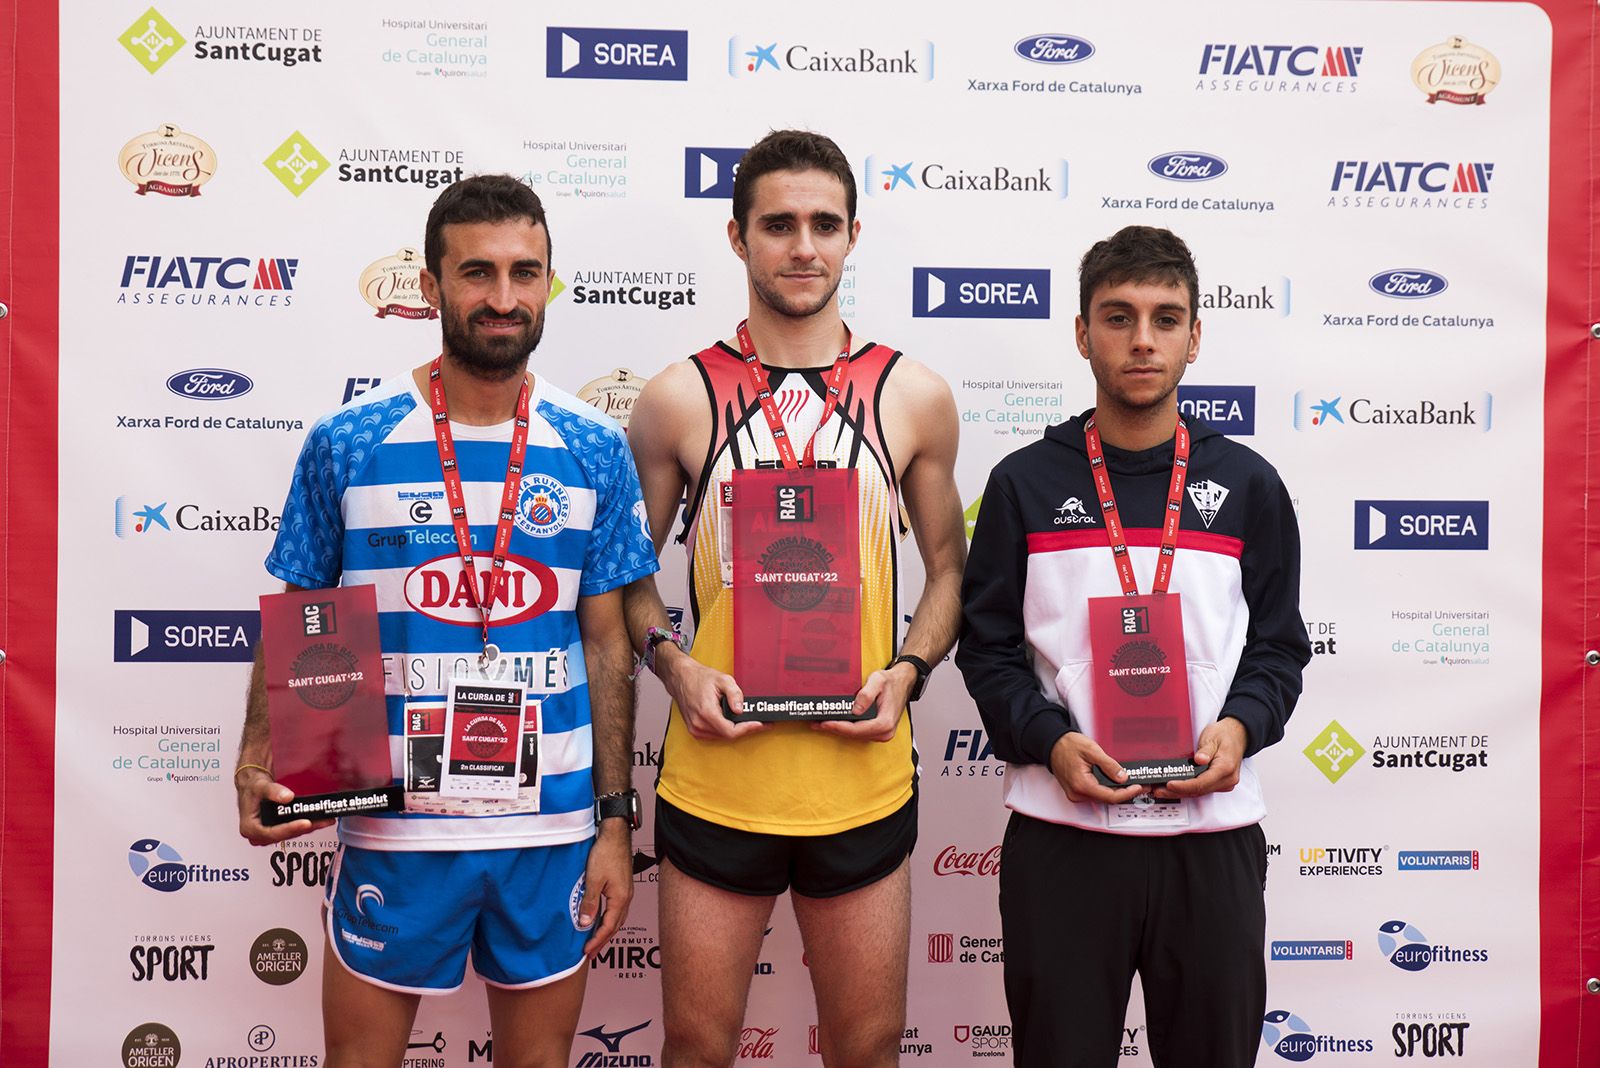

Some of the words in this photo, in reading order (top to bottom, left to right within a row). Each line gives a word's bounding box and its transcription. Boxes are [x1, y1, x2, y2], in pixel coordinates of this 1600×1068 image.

[382, 18, 426, 32] Hospital
[429, 19, 488, 31] Universitari
[195, 25, 299, 41] AJUNTAMENT
[303, 28, 323, 42] DE
[426, 32, 488, 49] General
[194, 40, 322, 67] SantCugat
[382, 48, 402, 63] de
[406, 49, 488, 66] Catalunya
[594, 42, 676, 67] SOREA
[1029, 37, 1080, 61] Ford
[785, 44, 918, 74] CaixaBank
[1198, 44, 1319, 77] FIATC
[967, 79, 1008, 92] Xarxa
[1012, 79, 1044, 92] Ford
[1048, 80, 1066, 93] de
[1068, 80, 1142, 96] Catalunya
[1195, 79, 1358, 94] ASSEGURANCES
[523, 140, 566, 152] Hospital
[569, 141, 627, 152] Universitari
[338, 148, 442, 163] AJUNTAMENT
[446, 150, 464, 164] DE
[566, 154, 627, 169] General
[1163, 155, 1212, 178] Ford
[338, 164, 464, 188] SantCugat
[523, 170, 542, 184] de
[546, 170, 627, 188] Catalunya
[921, 163, 1053, 193] CaixaBank
[1330, 160, 1450, 194] FIATC
[148, 184, 189, 194] AGRAMUNT
[1101, 196, 1142, 209] Xarxa
[1146, 196, 1178, 210] Ford
[1181, 197, 1198, 210] de
[1202, 198, 1274, 213] Catalunya
[1328, 196, 1488, 210] ASSEGURANCES
[120, 256, 251, 290] FIATC
[574, 271, 674, 285] AJUNTAMENT
[678, 272, 696, 286] DE
[1384, 272, 1433, 296] Ford
[117, 292, 292, 308] ASSEGURANCES
[573, 286, 696, 310] SantCugat
[959, 282, 1039, 306] SOREA
[1202, 284, 1275, 310] aBank
[388, 307, 428, 318] AGRAMUNT
[1323, 314, 1363, 326] Xarxa
[1366, 314, 1399, 327] Ford
[1402, 314, 1420, 327] de
[1422, 314, 1494, 330] Catalunya
[182, 373, 236, 396] Ford
[962, 380, 1004, 391] Hospital
[1006, 380, 1063, 390] Universitari
[1004, 392, 1063, 407] General
[962, 409, 981, 422] de
[985, 408, 1063, 425] Catalunya
[1349, 398, 1476, 426] CaixaBank
[116, 416, 162, 429] Xarxa
[165, 416, 200, 430] Ford
[203, 416, 222, 430] de
[225, 416, 304, 433] Catalunya
[176, 504, 282, 533] CaixaBa
[1400, 515, 1478, 536] SOREA
[754, 573, 783, 582] SANT
[420, 570, 526, 608] DANI
[1391, 610, 1432, 622] Hospital
[1434, 610, 1490, 620] Universitari
[164, 625, 249, 648] SOREA
[1318, 622, 1336, 635] DE
[1432, 623, 1490, 638] General
[1392, 639, 1410, 654] de
[1415, 639, 1490, 656] Catalunya
[1108, 668, 1130, 676] SANT
[288, 677, 314, 688] SANT
[458, 692, 467, 700] LA
[468, 692, 494, 702] CURSA
[496, 694, 506, 702] DE
[743, 702, 755, 712] 1r
[756, 700, 815, 712] Classificat
[113, 725, 158, 736] Hospital
[160, 725, 220, 736] Universitari
[158, 738, 220, 752] General
[1373, 734, 1468, 748] AJUNTAMENT
[1471, 734, 1488, 748] DE
[112, 755, 133, 770] de
[138, 755, 220, 772] Catalunya
[469, 764, 504, 772] CLASSIFICAT
[1163, 764, 1194, 774] absolut
[1372, 750, 1488, 772] SantCugat
[277, 804, 292, 816] 2n
[293, 799, 348, 812] Classificat
[349, 794, 388, 806] absolut
[1300, 848, 1382, 864] UPTIVITY
[1400, 855, 1470, 866] VOLUNTARIS
[148, 864, 250, 884] eurofitness
[1300, 865, 1383, 876] EXPERIENCES
[256, 952, 302, 961] AMETLLER
[960, 951, 977, 963] de
[1272, 946, 1344, 956] VOLUNTARIS
[1396, 945, 1488, 964] eurofitness
[130, 945, 215, 982] SPORT
[256, 960, 302, 972] ORIGEN
[1395, 1012, 1433, 1020] TORRONS
[1438, 1012, 1467, 1020] VICENS
[1280, 1034, 1374, 1054] eurofitness
[1392, 1022, 1470, 1058] SPORT
[129, 1048, 174, 1056] AMETLLER
[128, 1056, 174, 1068] ORIGEN
[205, 1056, 318, 1068] APROPERTIES
